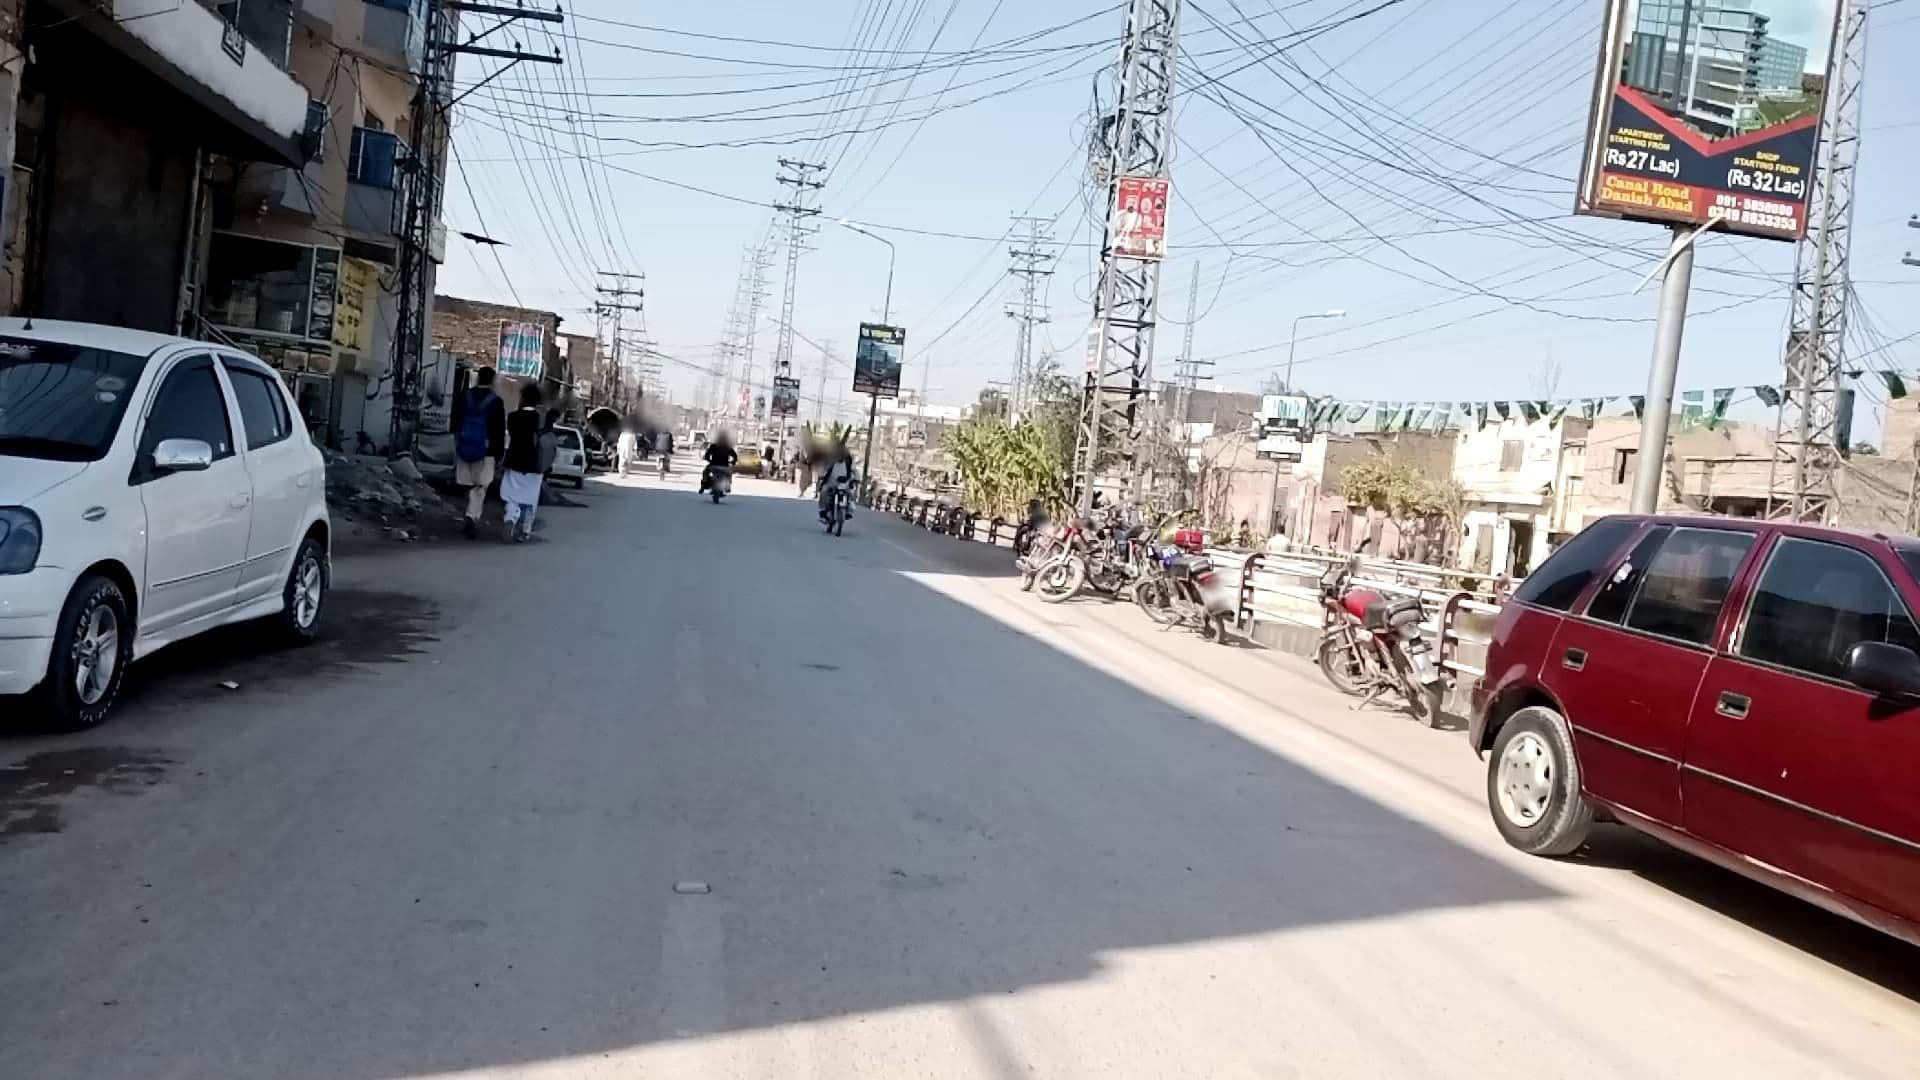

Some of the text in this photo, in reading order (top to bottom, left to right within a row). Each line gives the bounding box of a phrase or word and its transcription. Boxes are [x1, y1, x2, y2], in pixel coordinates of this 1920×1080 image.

[1649, 154, 1680, 178] Lac)
[1601, 187, 1693, 213] Danish Abad
[1606, 175, 1689, 200] Canal Road
